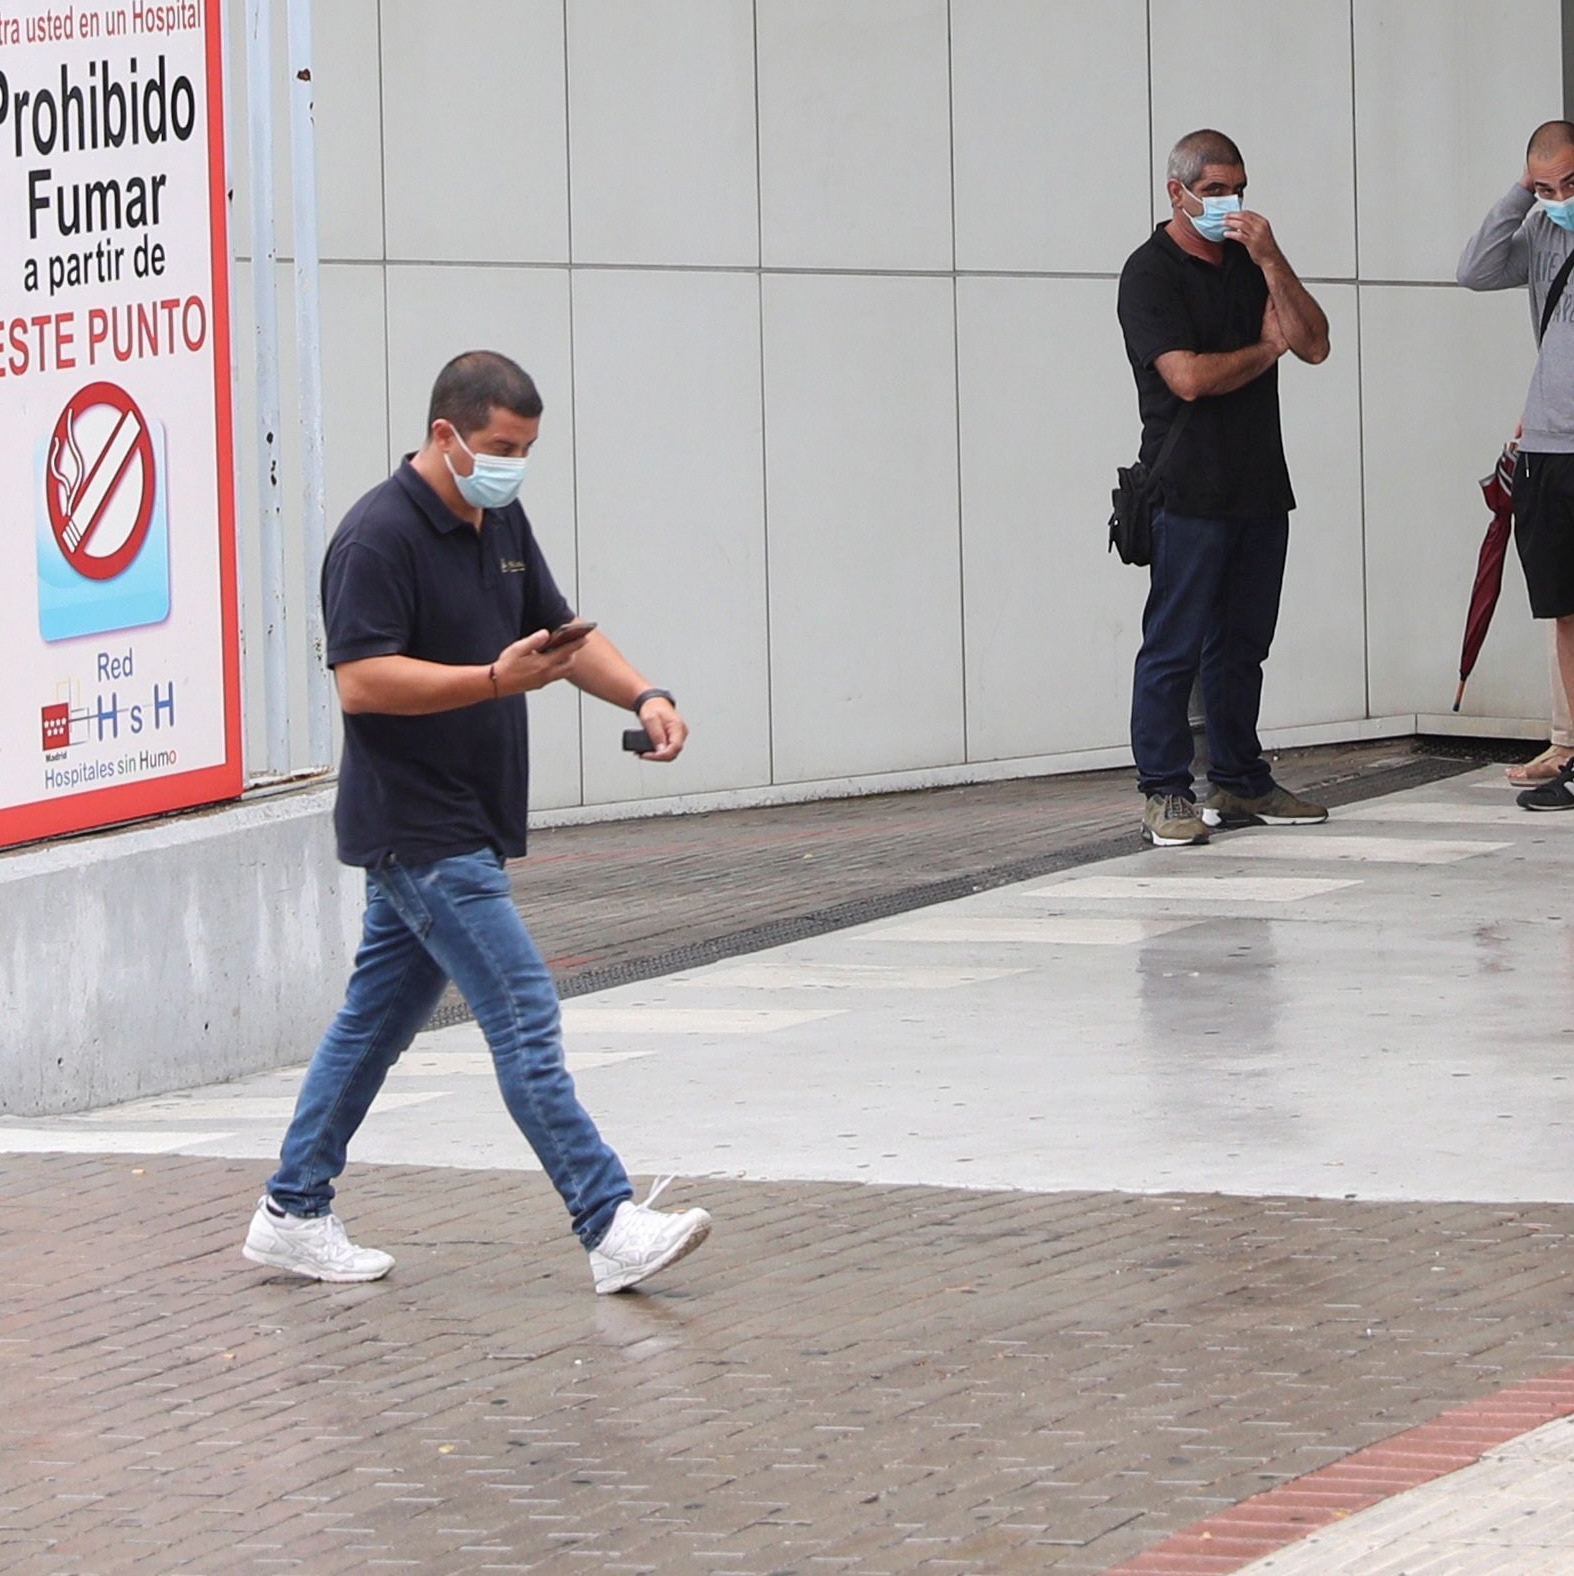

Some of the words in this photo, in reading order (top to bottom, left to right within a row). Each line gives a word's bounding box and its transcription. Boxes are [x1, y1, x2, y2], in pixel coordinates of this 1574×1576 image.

[26, 5, 74, 43] usted
[79, 13, 100, 39] en
[106, 9, 127, 36] un
[28, 169, 167, 240] Fumar
[24, 256, 39, 292] a
[49, 238, 125, 296] partir
[133, 234, 166, 279] de
[88, 295, 207, 366] PUNTO
[97, 647, 133, 683] Red
[97, 692, 118, 742] H
[153, 681, 174, 730] H
[44, 760, 115, 790] Hospitales
[117, 754, 137, 775] sin
[139, 749, 177, 772] Humo
